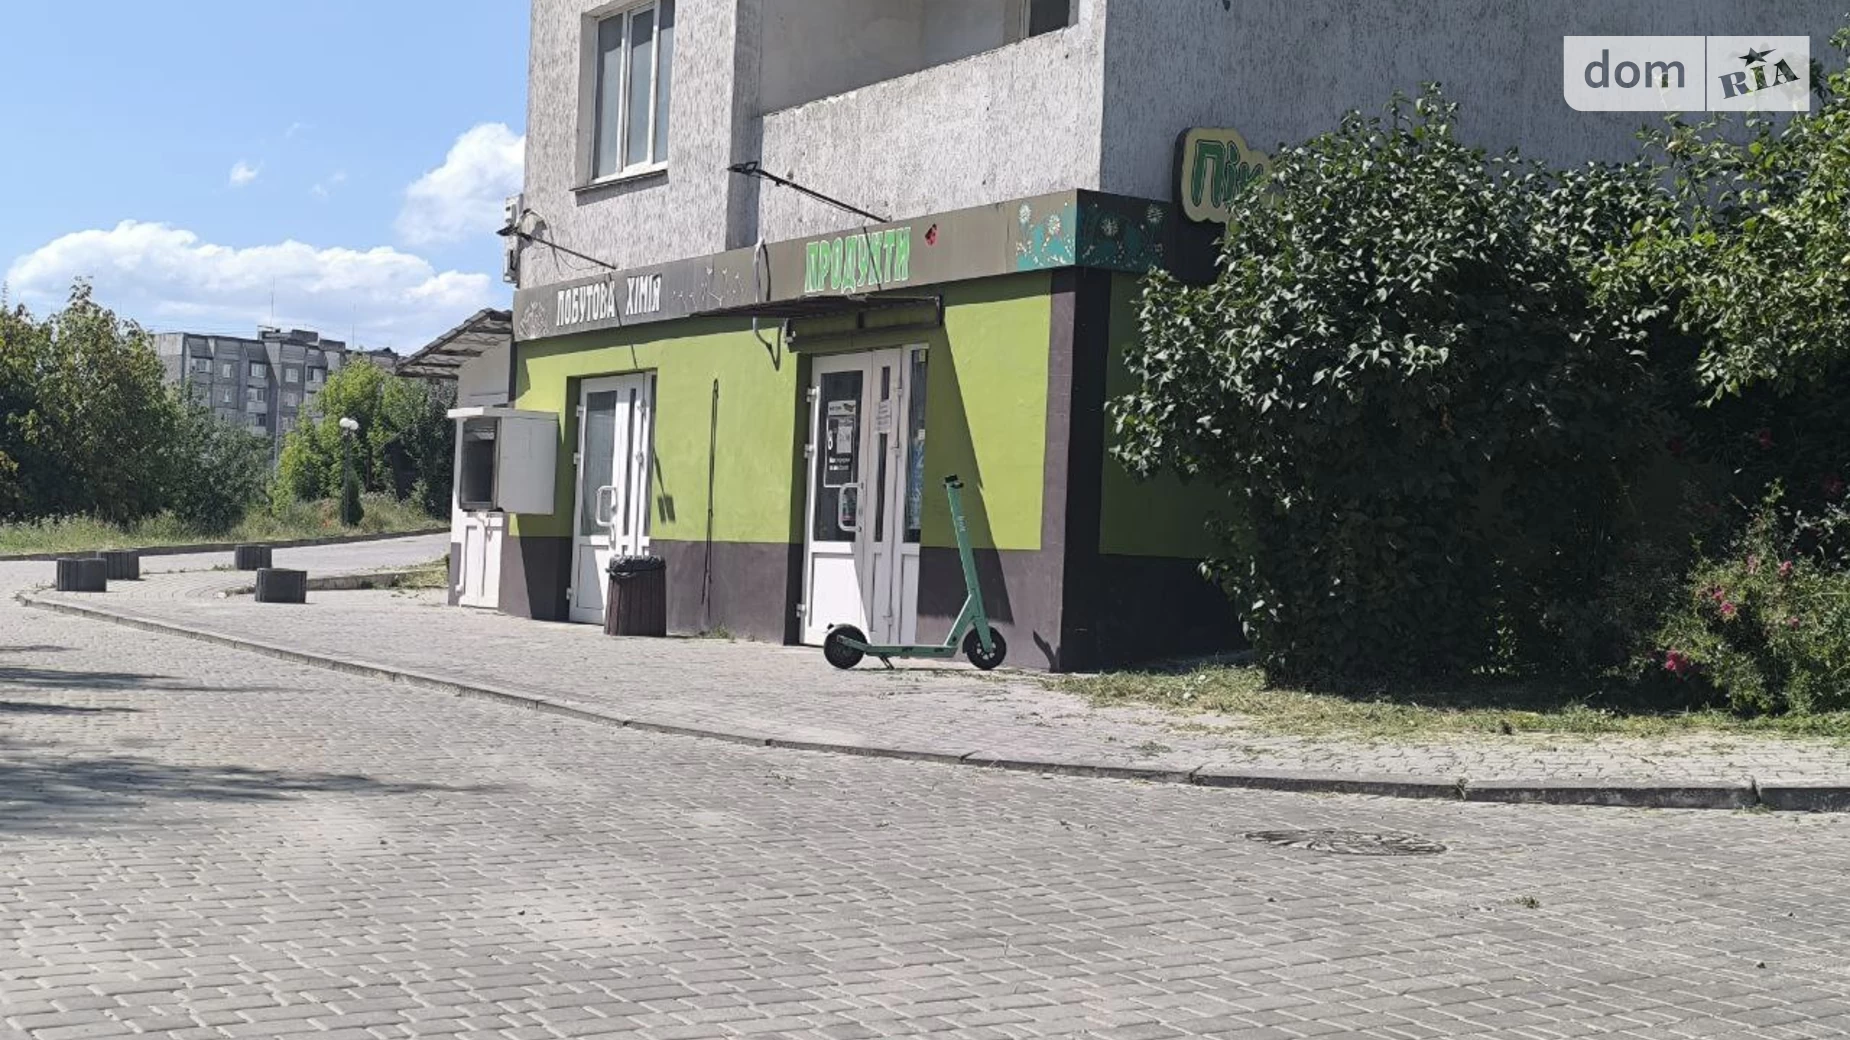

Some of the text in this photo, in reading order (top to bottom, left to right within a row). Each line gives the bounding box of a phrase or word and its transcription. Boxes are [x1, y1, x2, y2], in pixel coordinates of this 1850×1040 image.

[804, 226, 911, 294] ПРОДУКТИ
[556, 274, 662, 326] ПОБУТОВА ХІМІЯ
